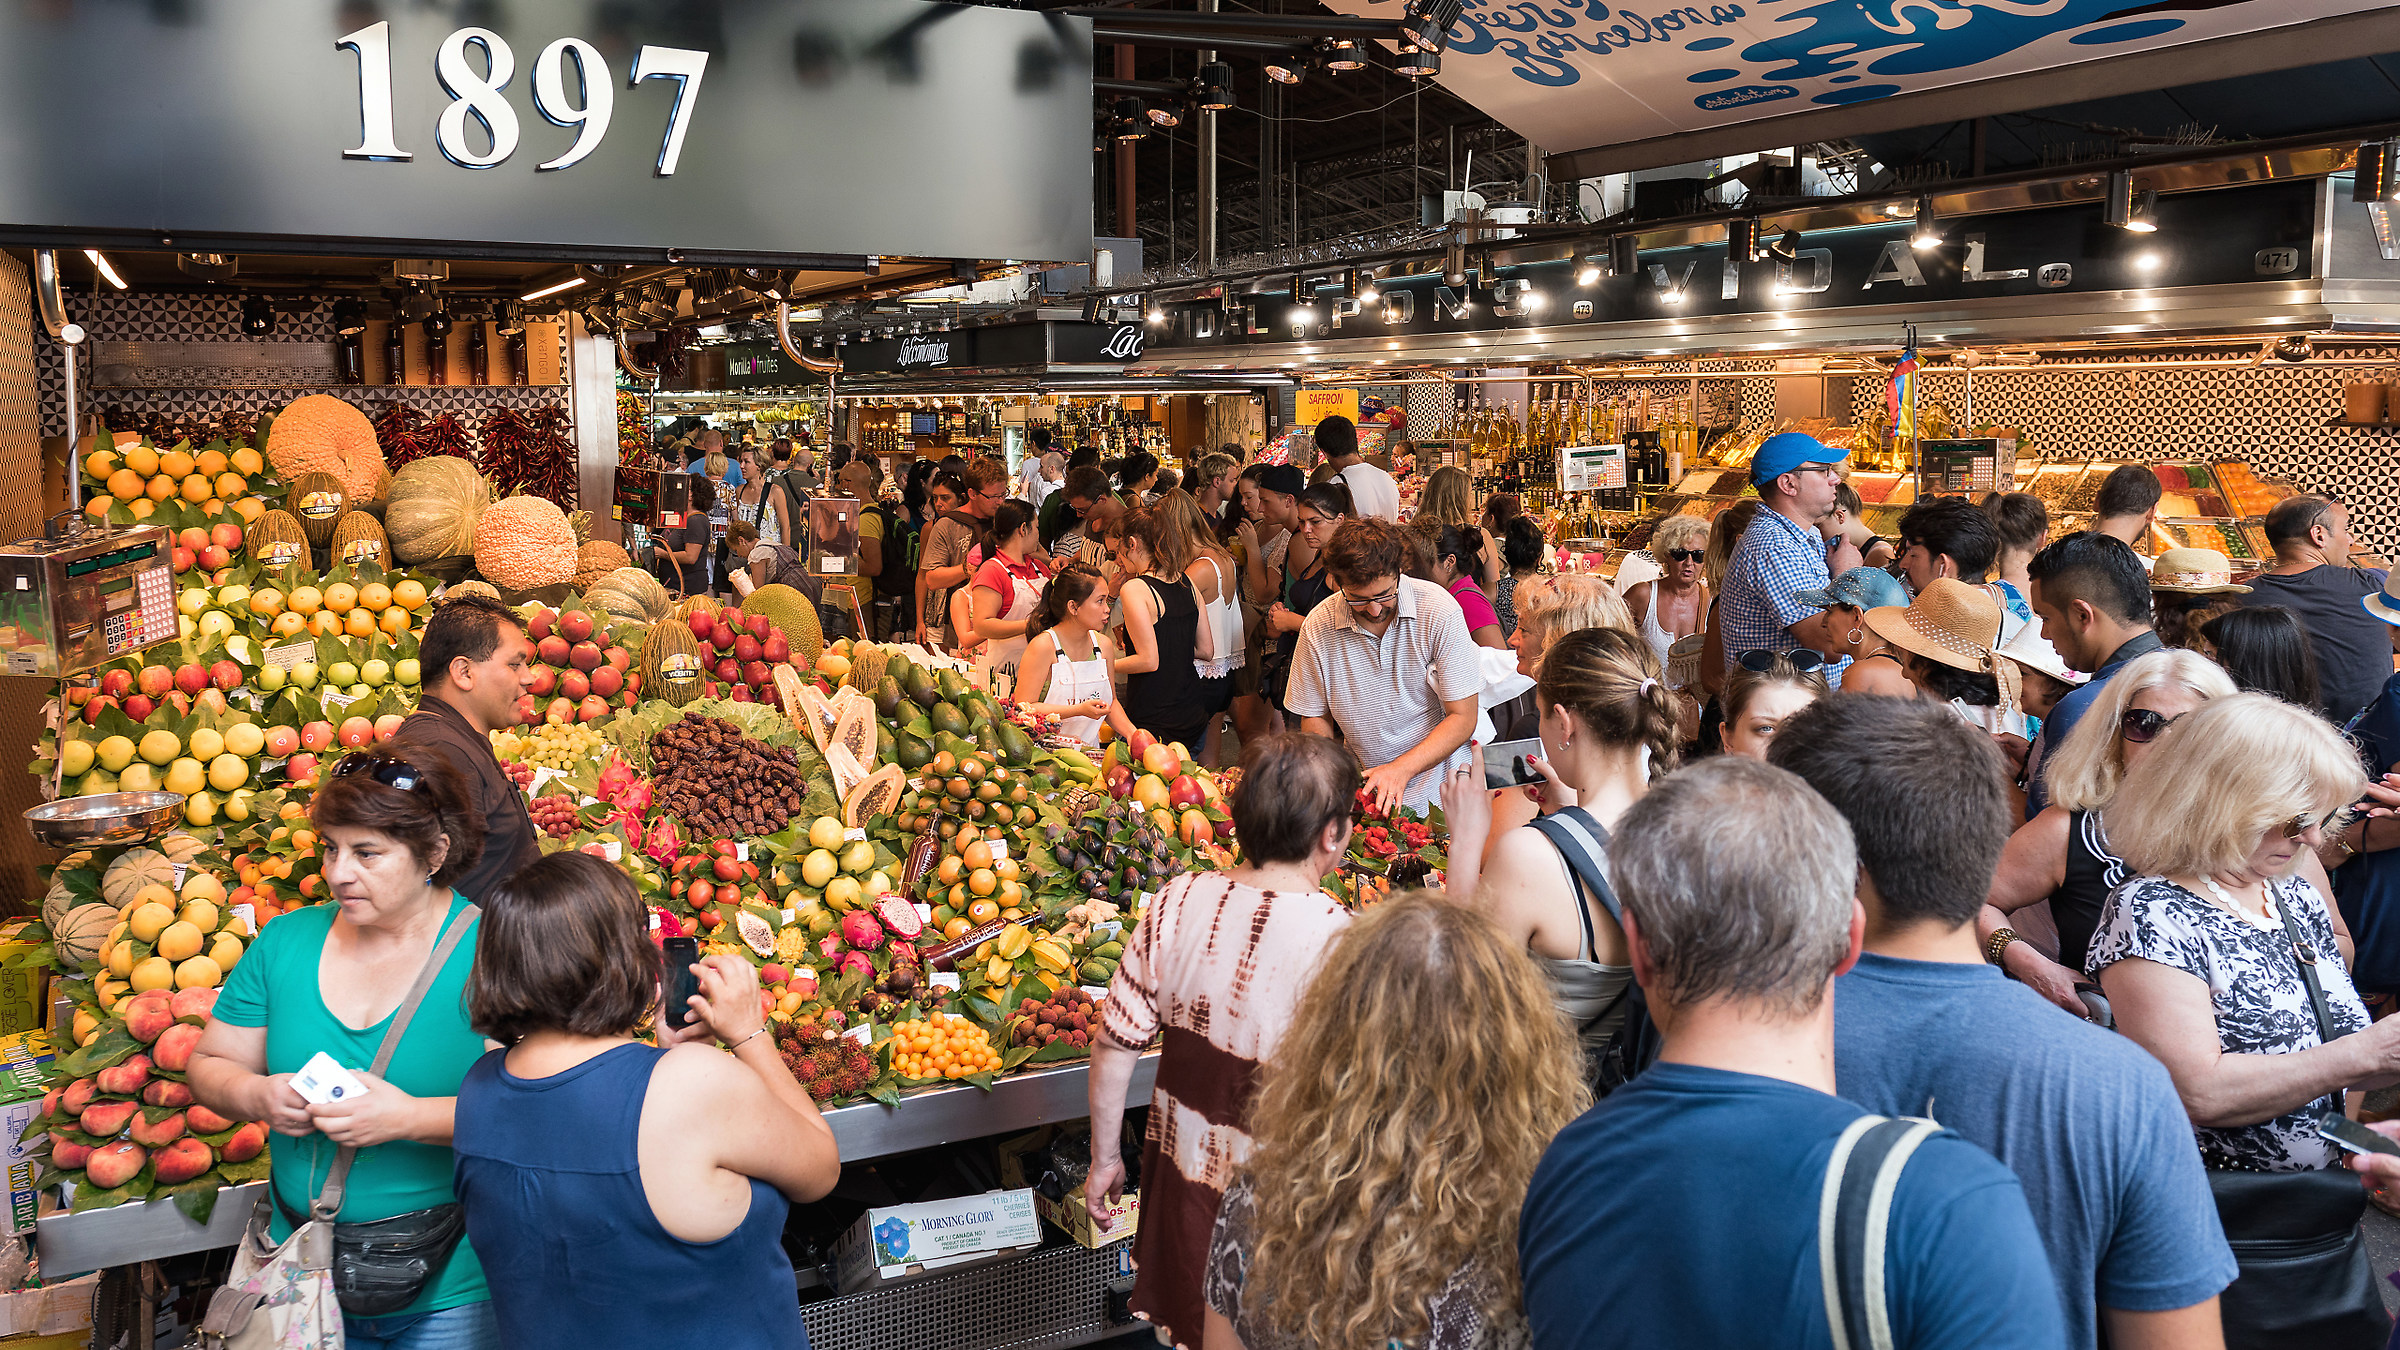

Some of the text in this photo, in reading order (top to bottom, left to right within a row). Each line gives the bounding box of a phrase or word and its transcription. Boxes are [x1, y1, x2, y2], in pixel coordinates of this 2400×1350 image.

[1500, 4, 1746, 87] Barcelona
[334, 20, 711, 178] 1897
[2261, 253, 2290, 269] 471
[1332, 232, 2029, 329] PONS VIDAL
[2042, 268, 2067, 283] 472
[1575, 304, 1591, 316] 473
[1165, 304, 1269, 339] VIDAL
[729, 355, 779, 376] Morilla fruites
[1309, 393, 1343, 405] SAFFRON
[2, 968, 16, 1005] LOVER
[1019, 1194, 1030, 1203] kg
[1004, 1203, 1030, 1211] CHERRIES
[1009, 1210, 1032, 1219] CERISES
[952, 1232, 974, 1240] CANADA
